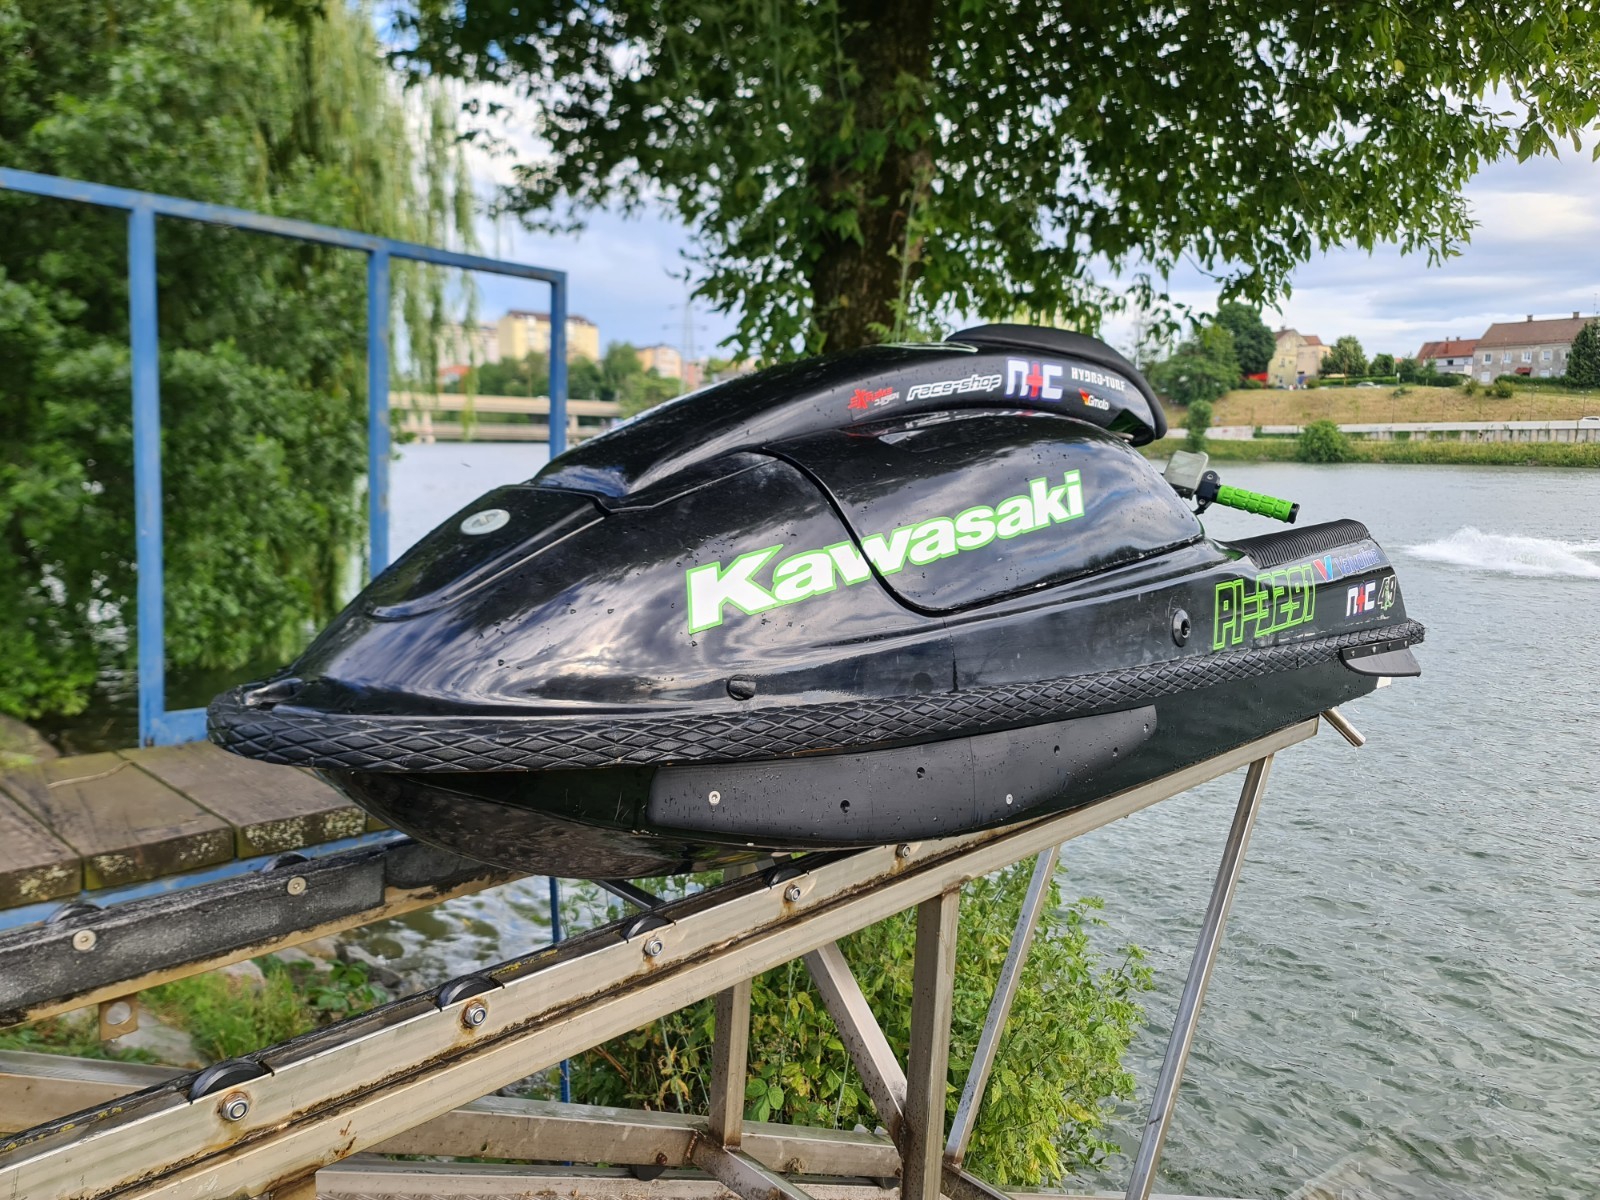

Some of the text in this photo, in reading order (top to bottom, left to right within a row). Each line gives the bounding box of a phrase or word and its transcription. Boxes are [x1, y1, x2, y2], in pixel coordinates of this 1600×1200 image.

[906, 374, 1002, 401] race-shop
[686, 469, 1086, 634] Kawasaki
[1335, 548, 1380, 576] Valvoline
